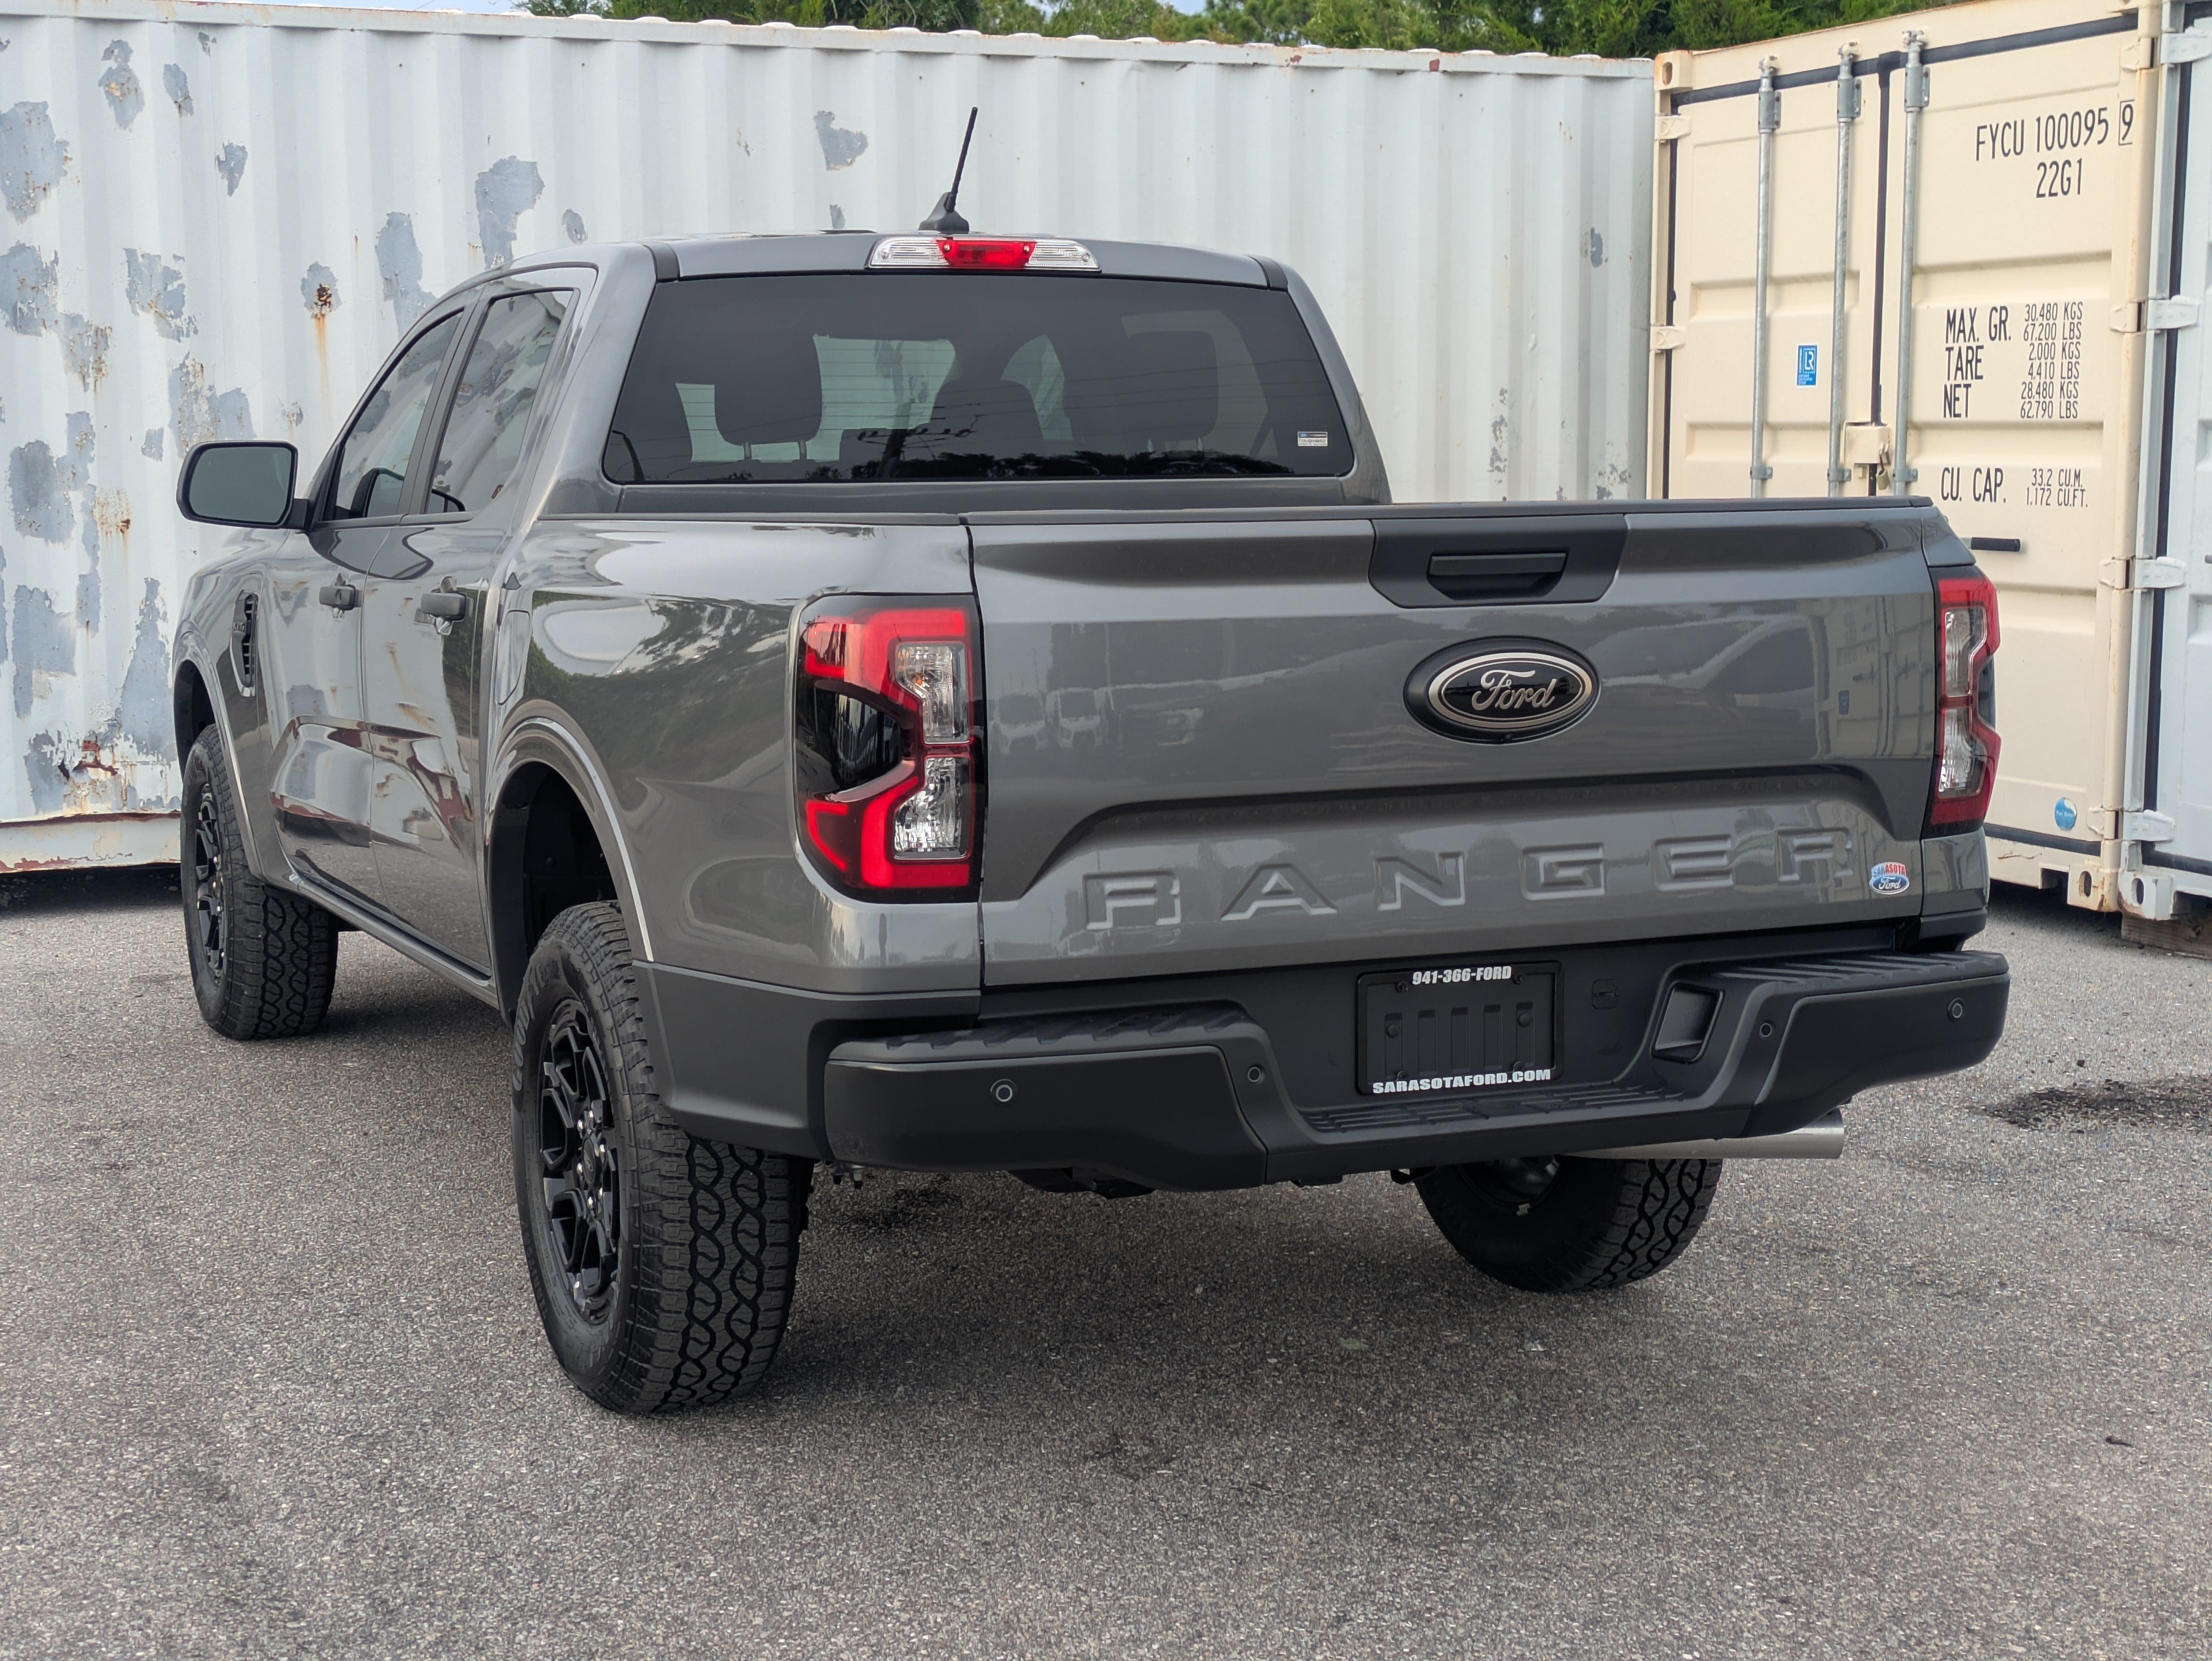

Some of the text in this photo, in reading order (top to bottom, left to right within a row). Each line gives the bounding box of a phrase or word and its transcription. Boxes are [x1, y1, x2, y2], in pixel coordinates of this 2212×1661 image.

[1975, 103, 2135, 162] FYCU 100095 9
[2035, 157, 2083, 199] 22G1
[2064, 301, 2083, 321] KGS
[1945, 305, 2012, 344] MAX. GR.
[2062, 321, 2082, 341] LBS
[2061, 341, 2081, 360] KGS
[1945, 344, 1984, 381] TARE
[2060, 361, 2080, 380] LBS
[2059, 380, 2079, 399] KGS
[1943, 383, 1972, 419] NET
[2059, 400, 2079, 419] LBS
[1941, 467, 2006, 503] CU. CAP.
[2031, 468, 2053, 487] 33.2
[1471, 670, 1557, 711] Ford
[1082, 827, 1854, 930] RANGER
[1872, 863, 1906, 877] SARASOTA
[1878, 876, 1902, 889] Ford
[1412, 966, 1512, 985] 941-366-FORD
[1372, 1069, 1551, 1094] SARASOTAFORD.COM
